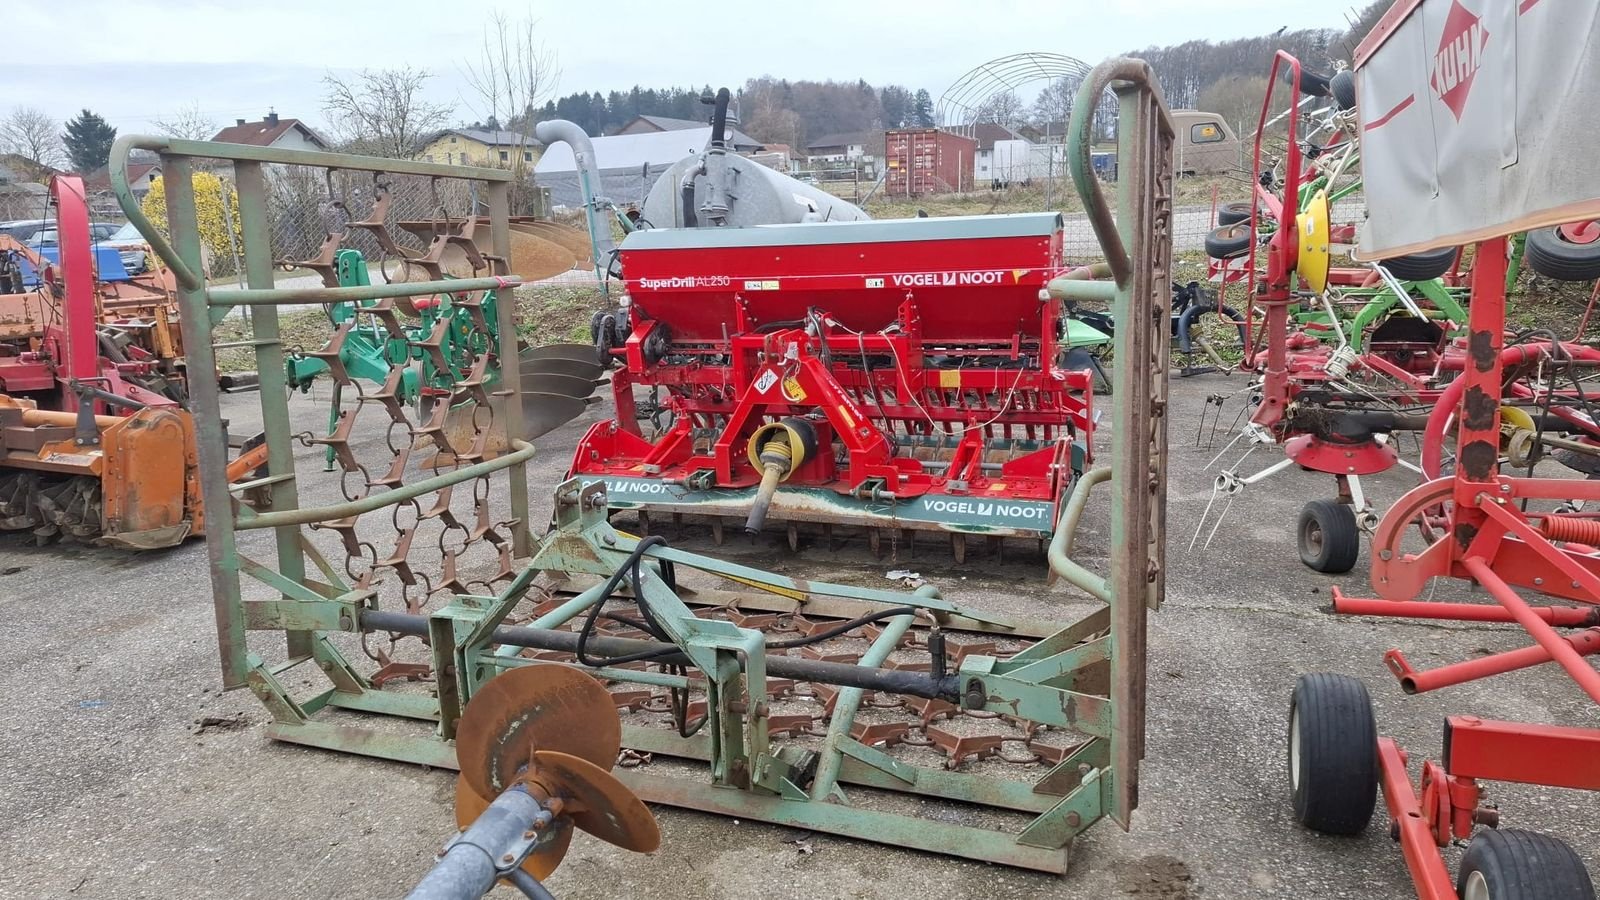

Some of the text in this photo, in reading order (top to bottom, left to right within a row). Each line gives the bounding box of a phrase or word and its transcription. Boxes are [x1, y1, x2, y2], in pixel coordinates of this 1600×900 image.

[1434, 17, 1482, 99] KUHN
[640, 276, 695, 291] SuperDrill
[696, 275, 730, 287] AL250
[893, 273, 941, 287] VOGEL
[960, 271, 1004, 285] NOOT
[629, 484, 670, 495] NOOT
[924, 500, 1046, 519] VOGEL NOOT
